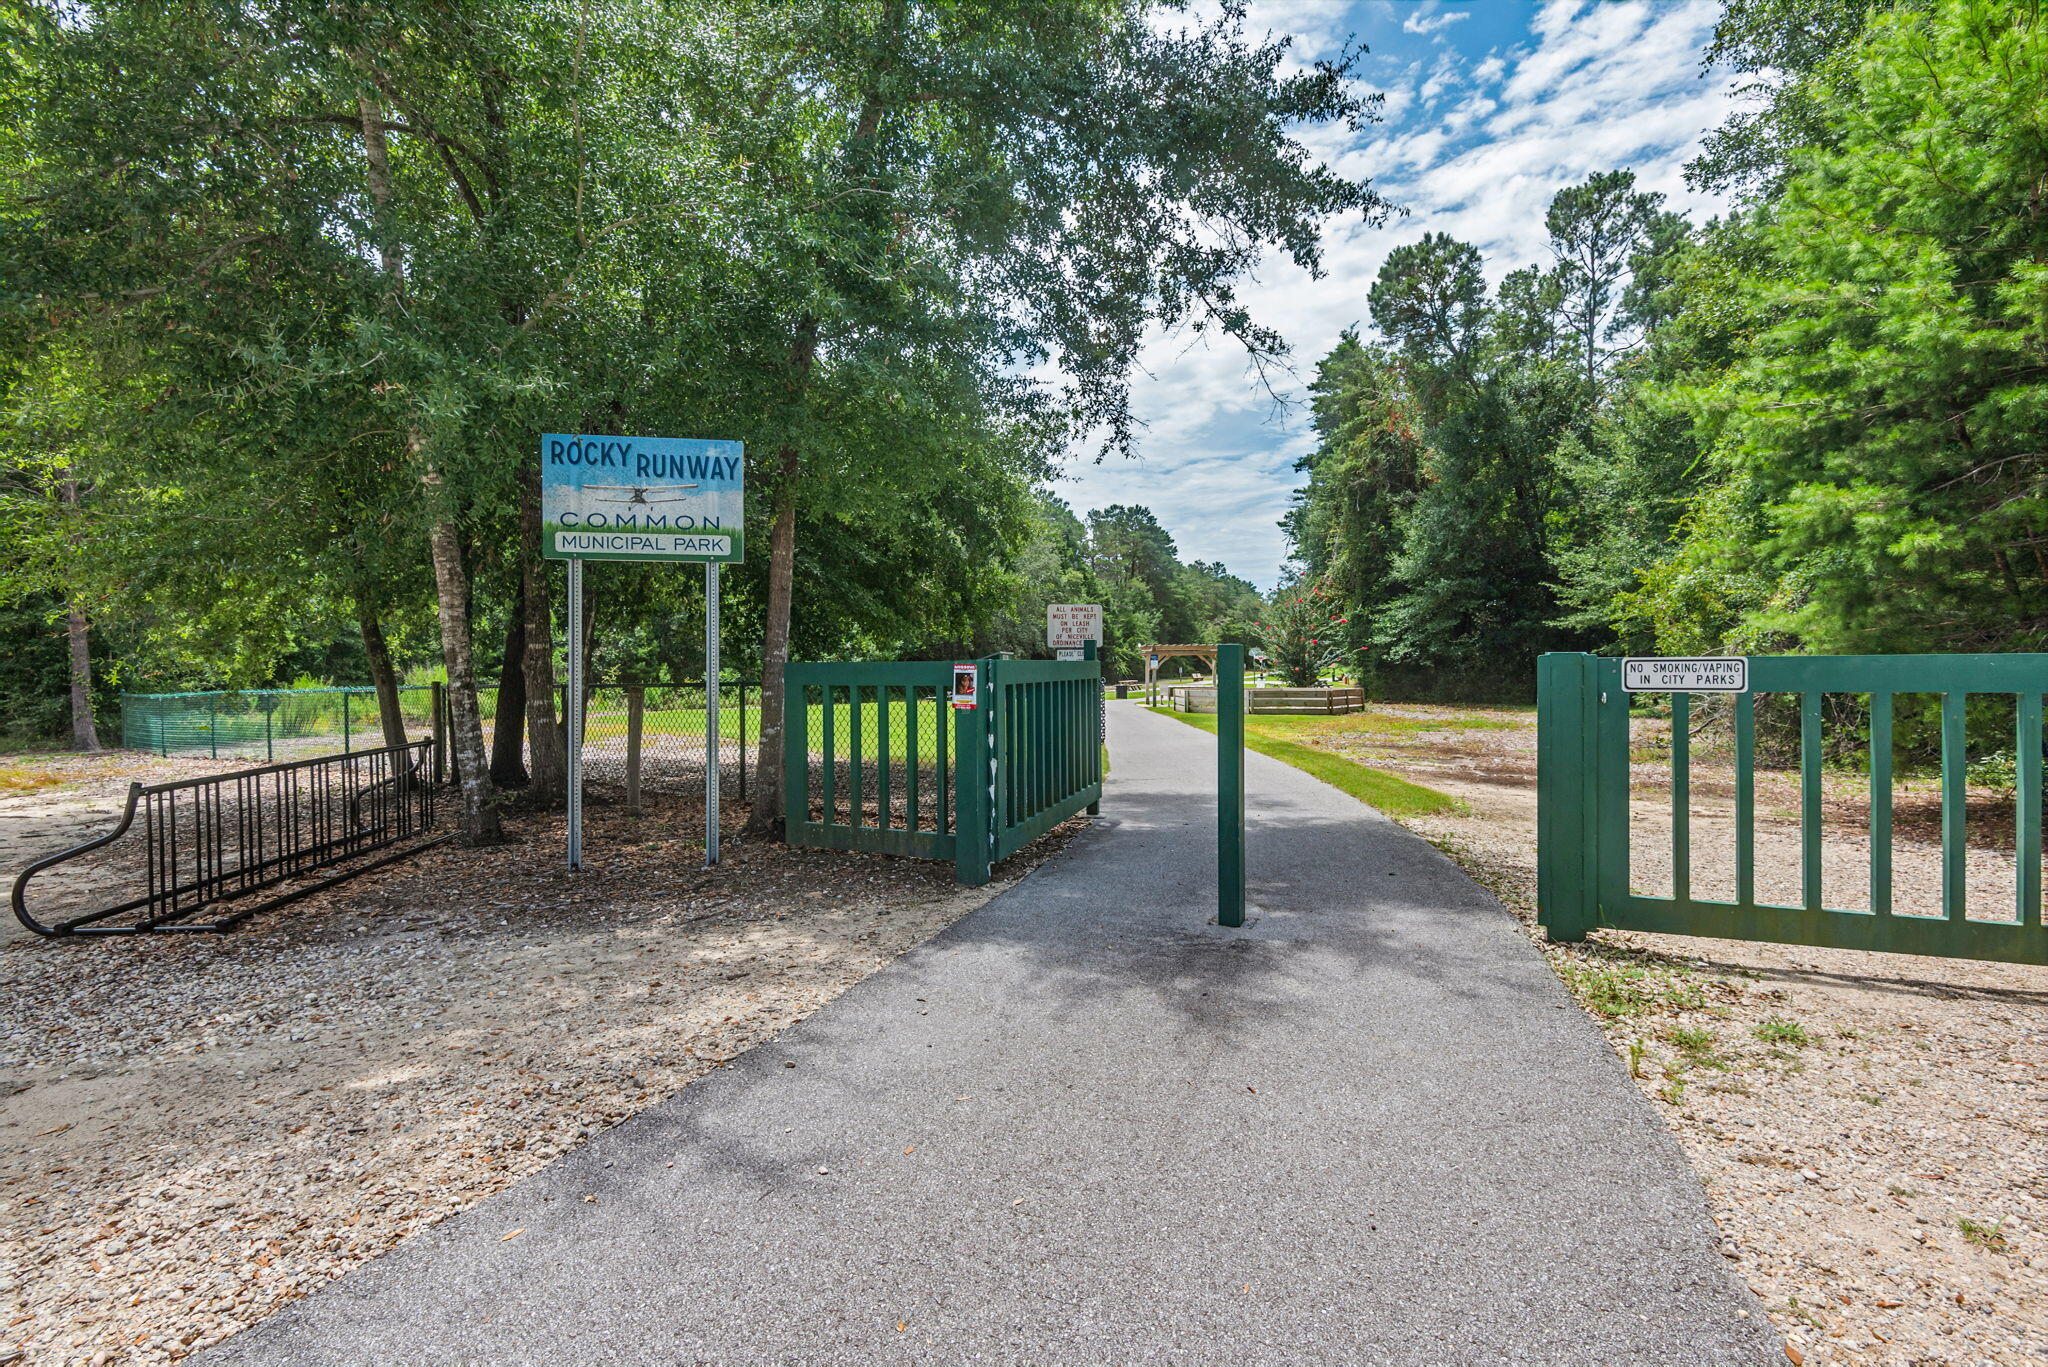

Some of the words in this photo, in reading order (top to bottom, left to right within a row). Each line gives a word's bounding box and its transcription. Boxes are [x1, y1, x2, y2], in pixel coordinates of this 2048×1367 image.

[551, 440, 633, 467] ROCKY
[636, 453, 740, 481] RUNWAY
[559, 511, 721, 531] COMMON
[562, 535, 666, 551] MUNICIPAL
[674, 537, 724, 553] PARK
[1630, 664, 1644, 673] NO
[1652, 663, 1740, 673] SMOKING/VAPING
[1640, 674, 1650, 684] IN
[1662, 674, 1686, 684] CITY
[1696, 674, 1736, 684] PARKS
